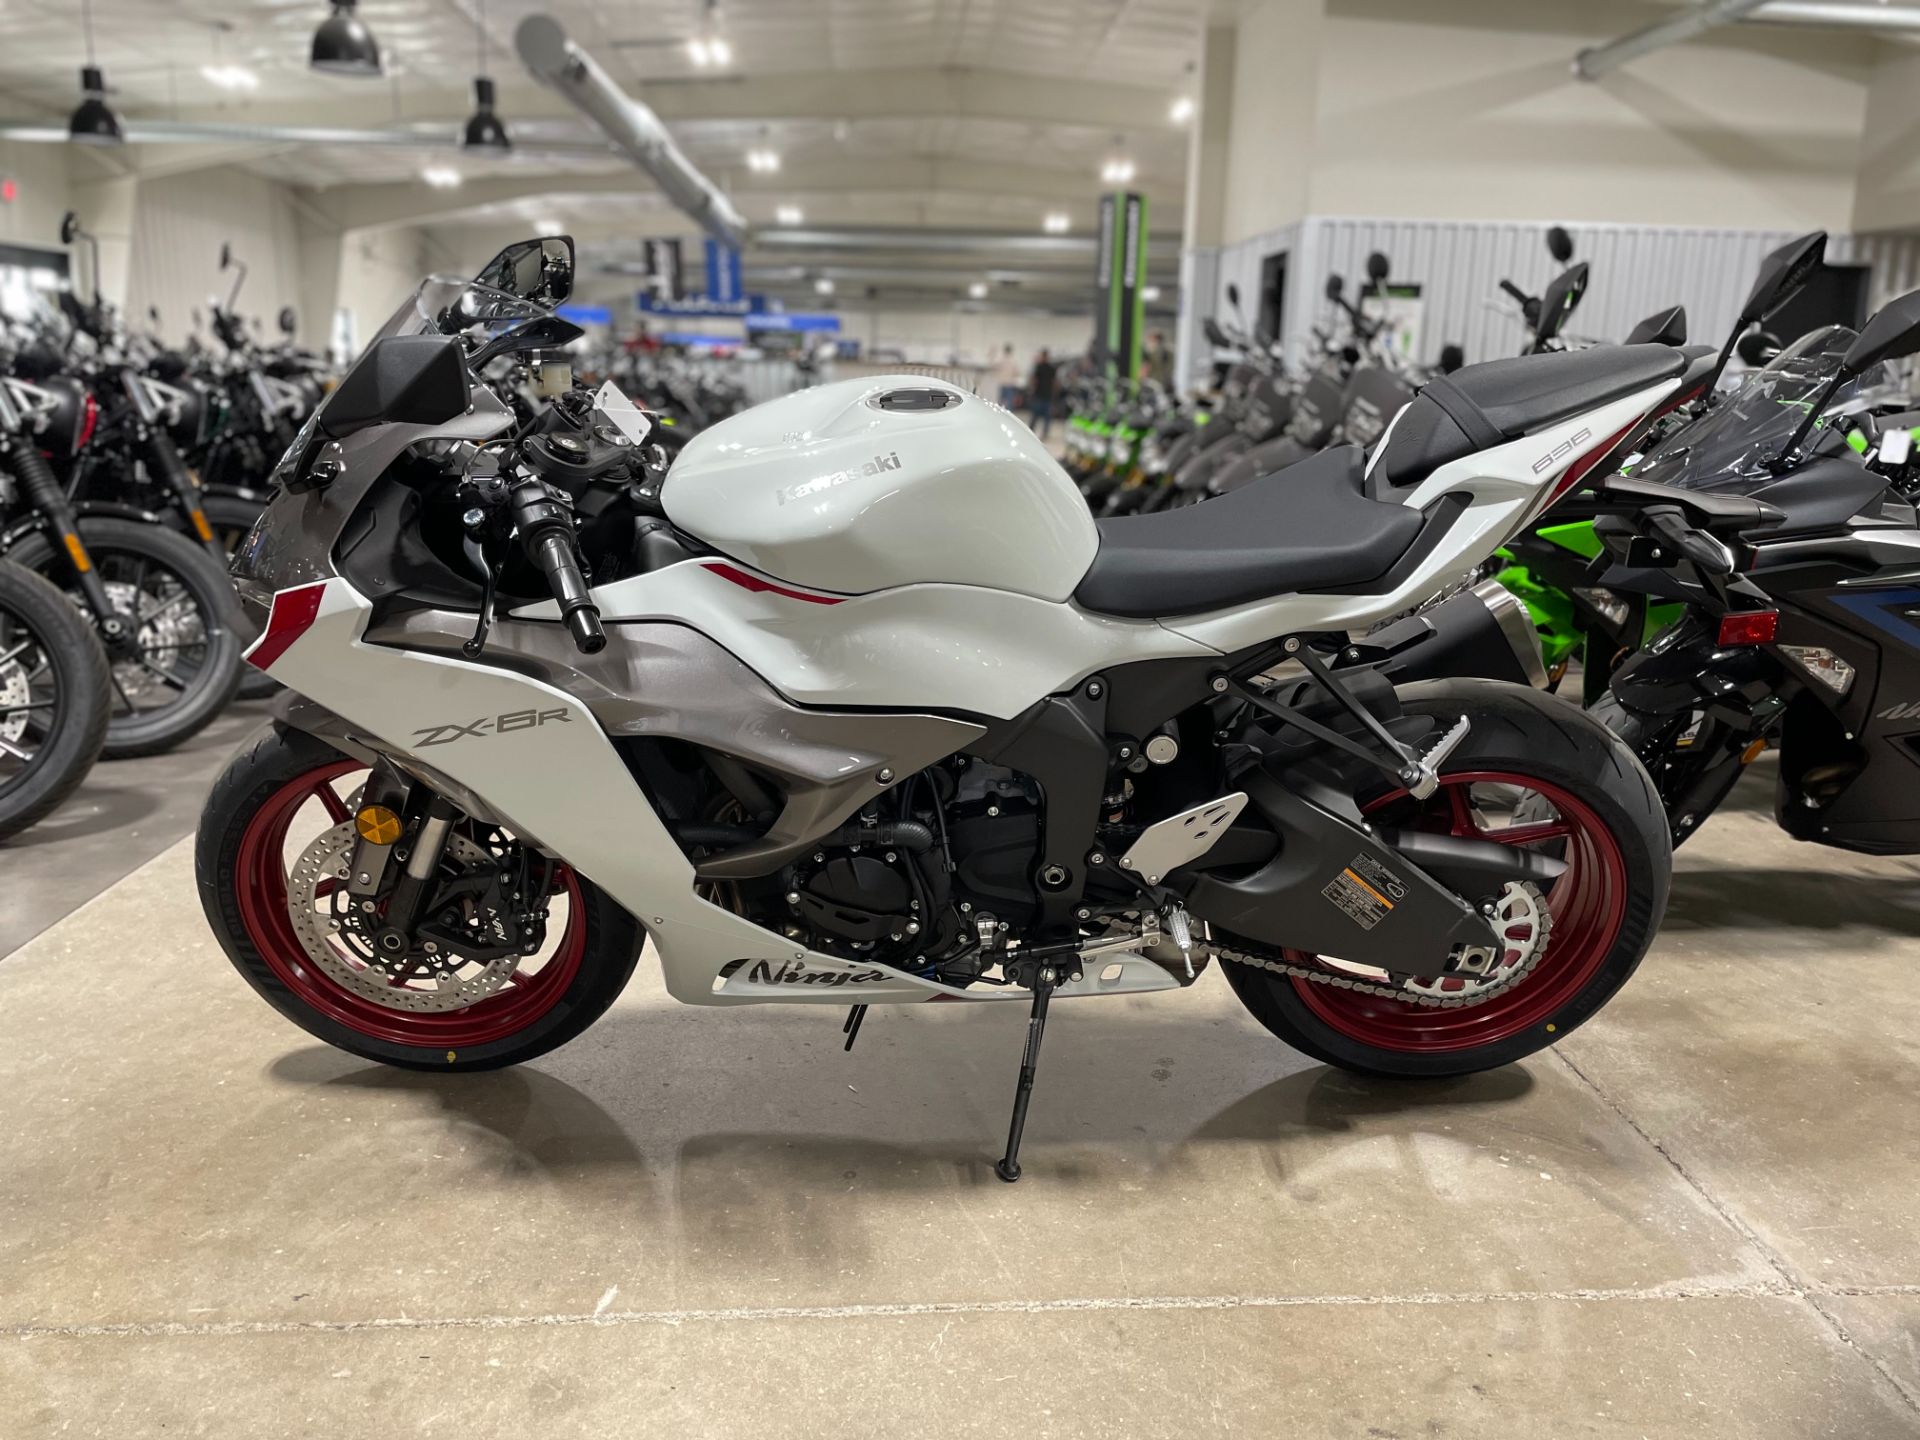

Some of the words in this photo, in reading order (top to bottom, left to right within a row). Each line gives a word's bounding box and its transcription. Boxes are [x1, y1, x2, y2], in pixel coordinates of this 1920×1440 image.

[1532, 427, 1592, 474] 636
[776, 451, 902, 506] Kawasaki
[411, 707, 573, 748] ZX-6R
[748, 958, 895, 988] Ninja
